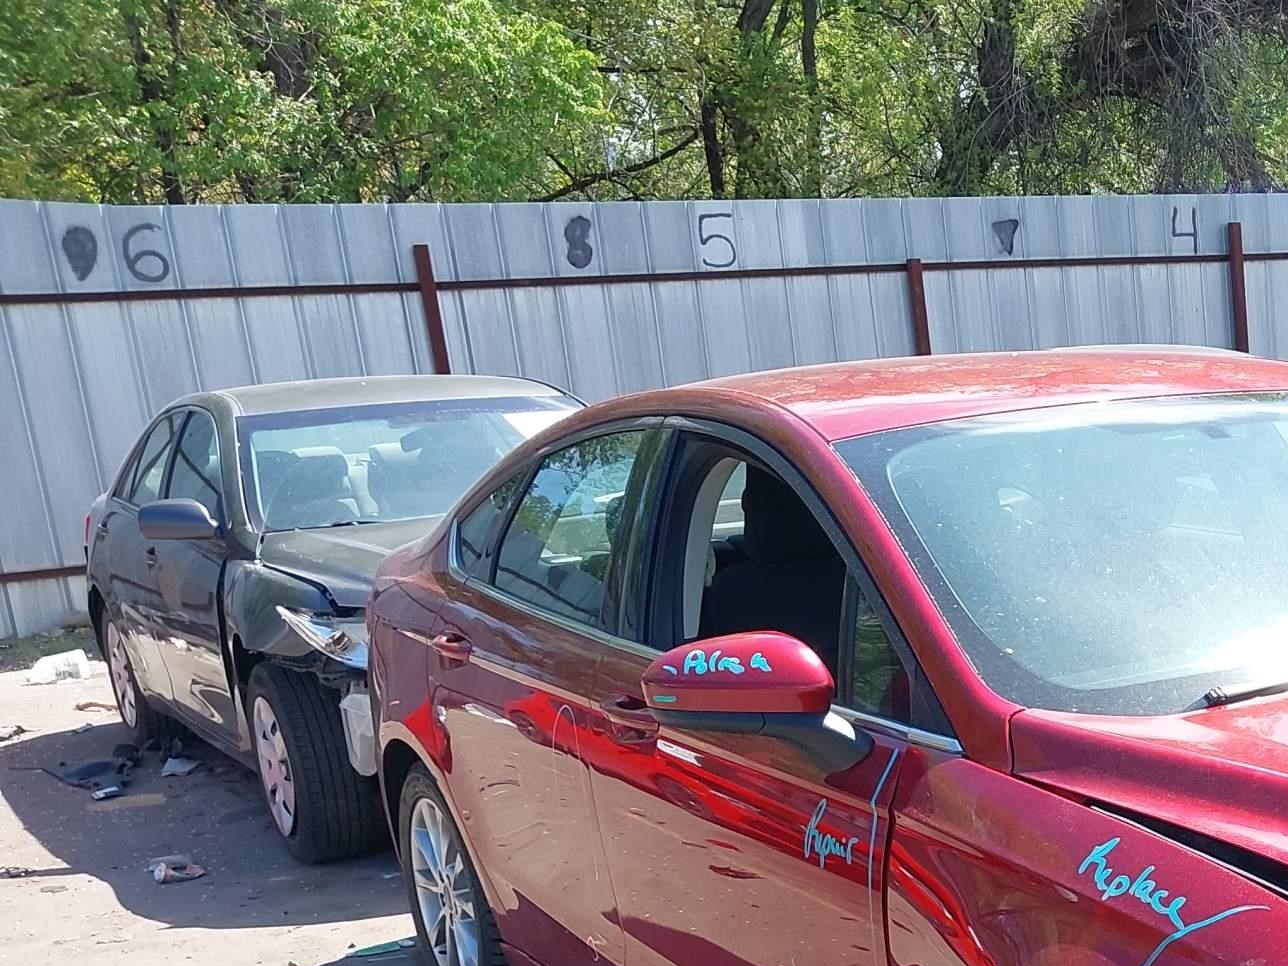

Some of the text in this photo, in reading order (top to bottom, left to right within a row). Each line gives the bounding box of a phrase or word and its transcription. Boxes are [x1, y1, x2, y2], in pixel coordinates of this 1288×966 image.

[122, 222, 170, 283] 6
[698, 213, 737, 268] 5
[1172, 206, 1198, 254] 4
